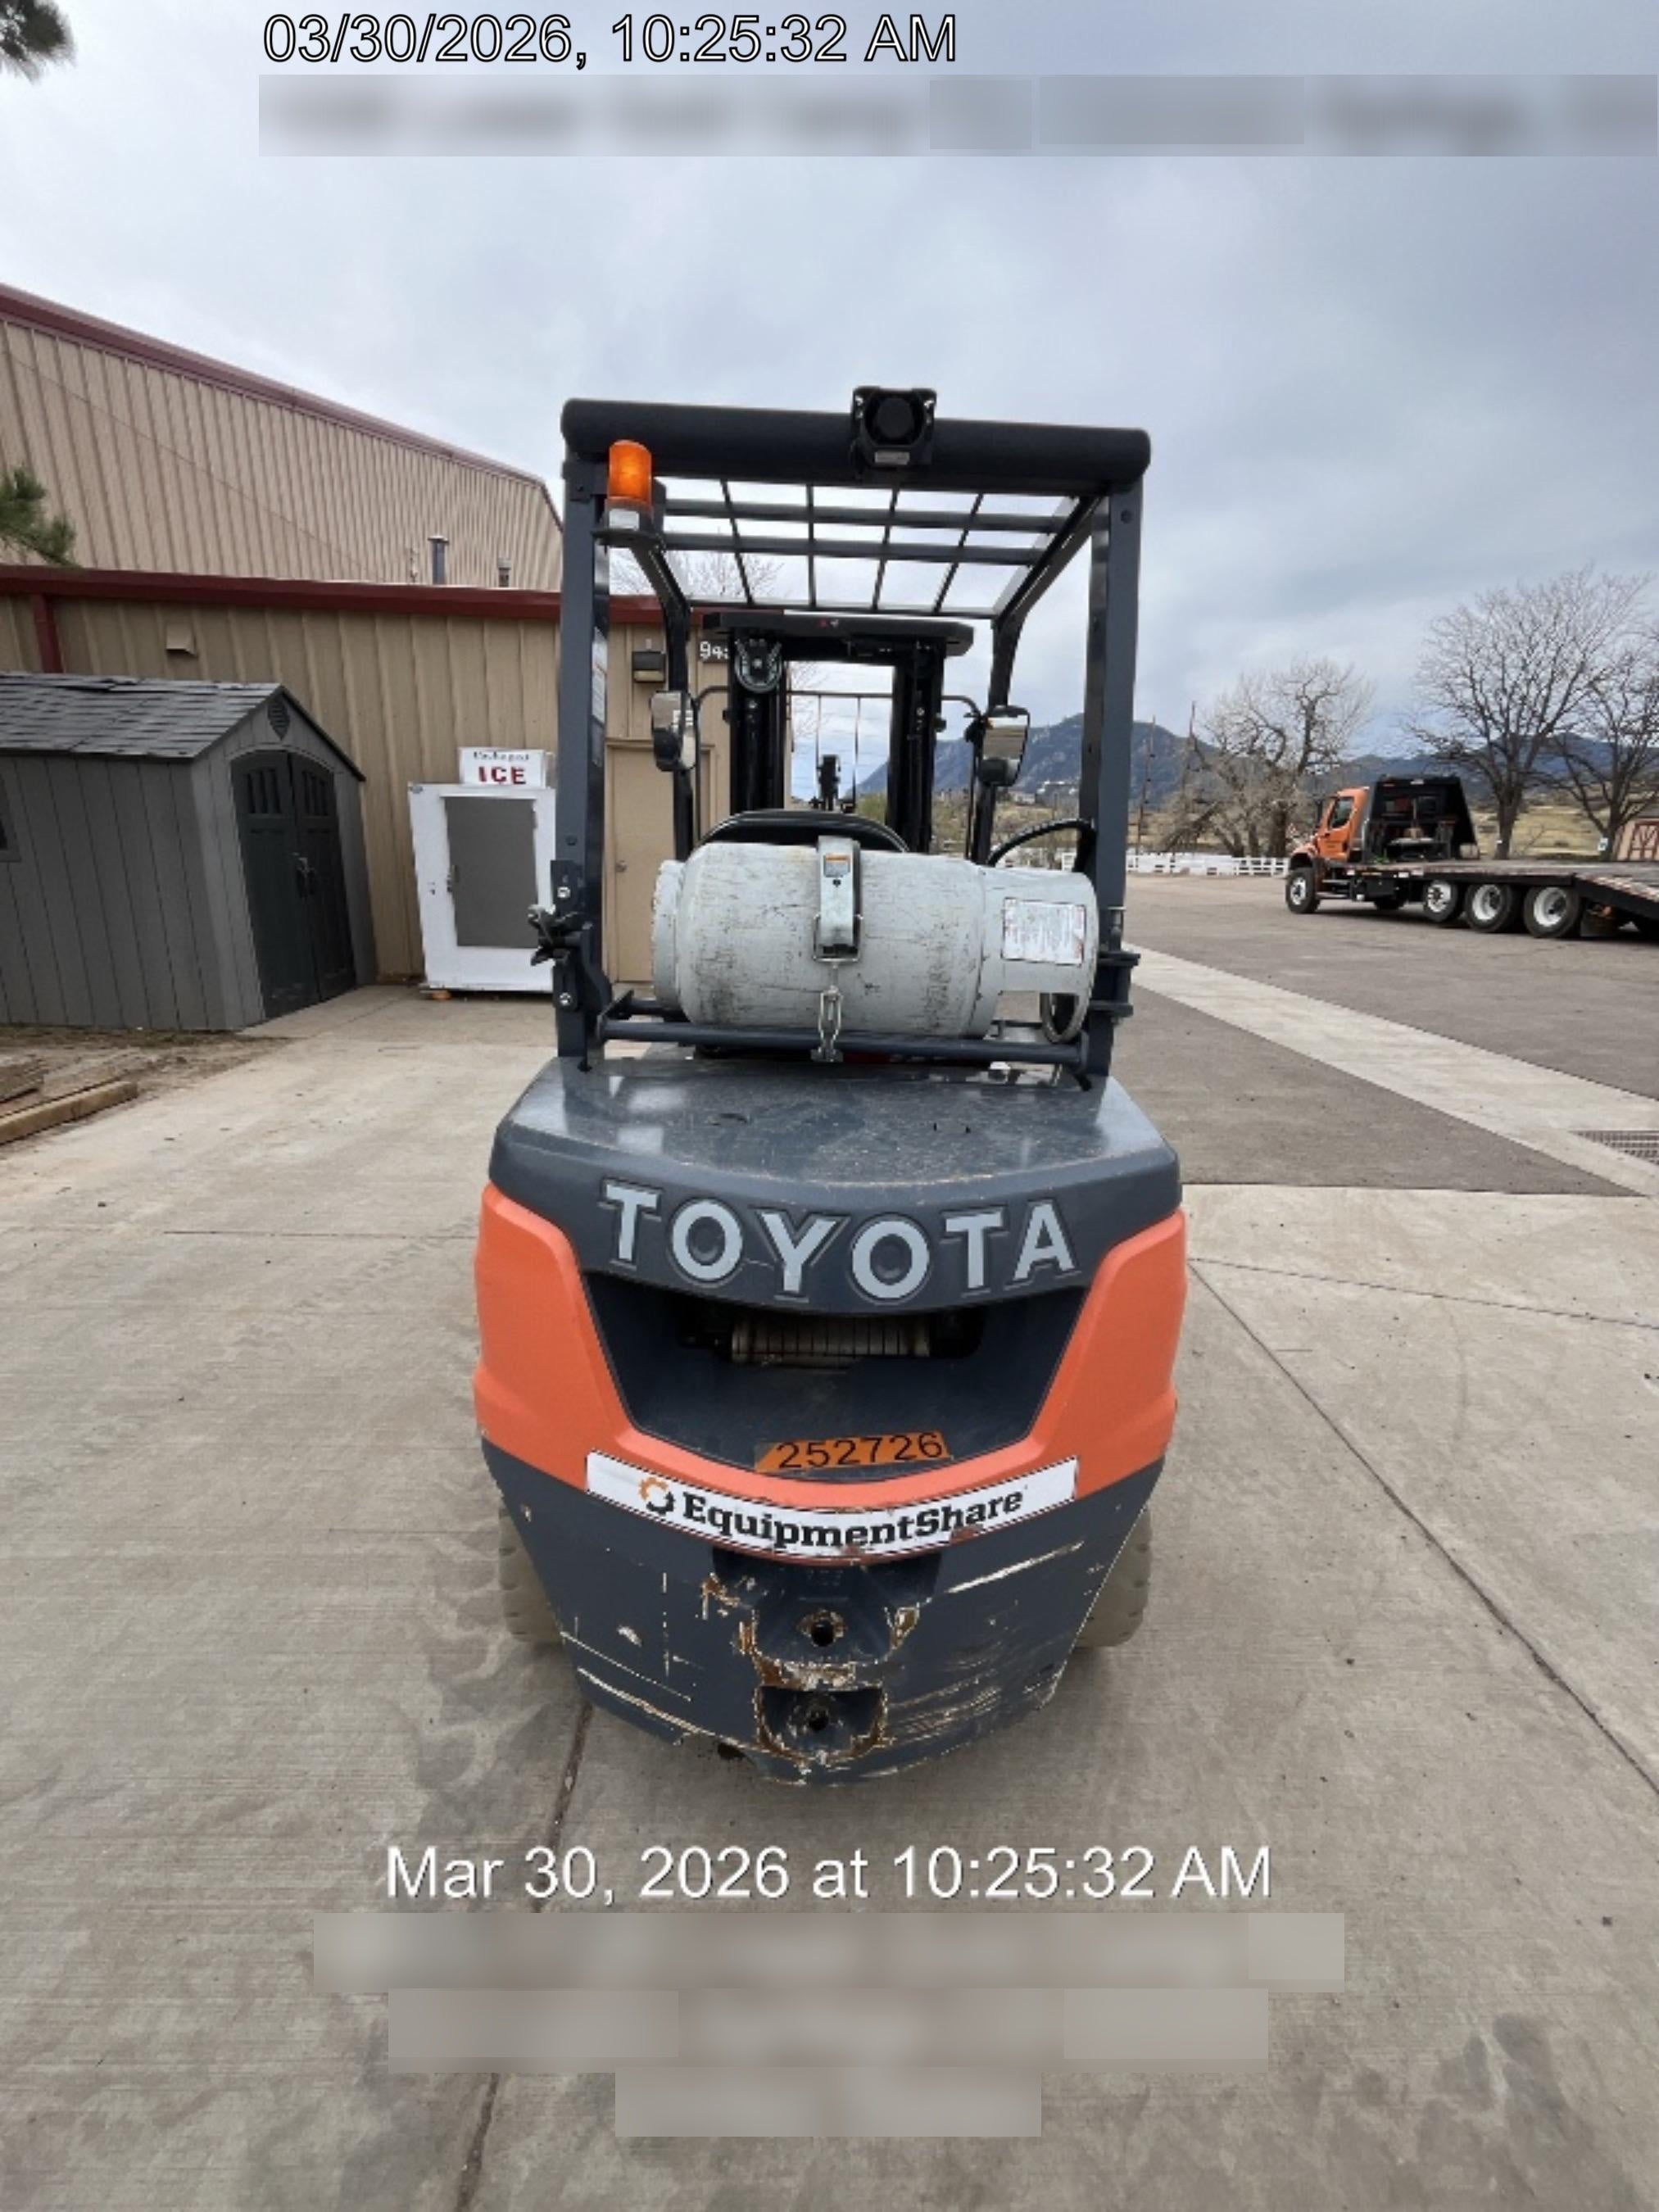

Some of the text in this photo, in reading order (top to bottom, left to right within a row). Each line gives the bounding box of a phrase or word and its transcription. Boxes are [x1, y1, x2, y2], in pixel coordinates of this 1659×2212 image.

[478, 766, 527, 785] ICE
[601, 1180, 1077, 1303] TOYOTA
[777, 1433, 943, 1468] 252726
[682, 1490, 1024, 1548] EquipmentShare
